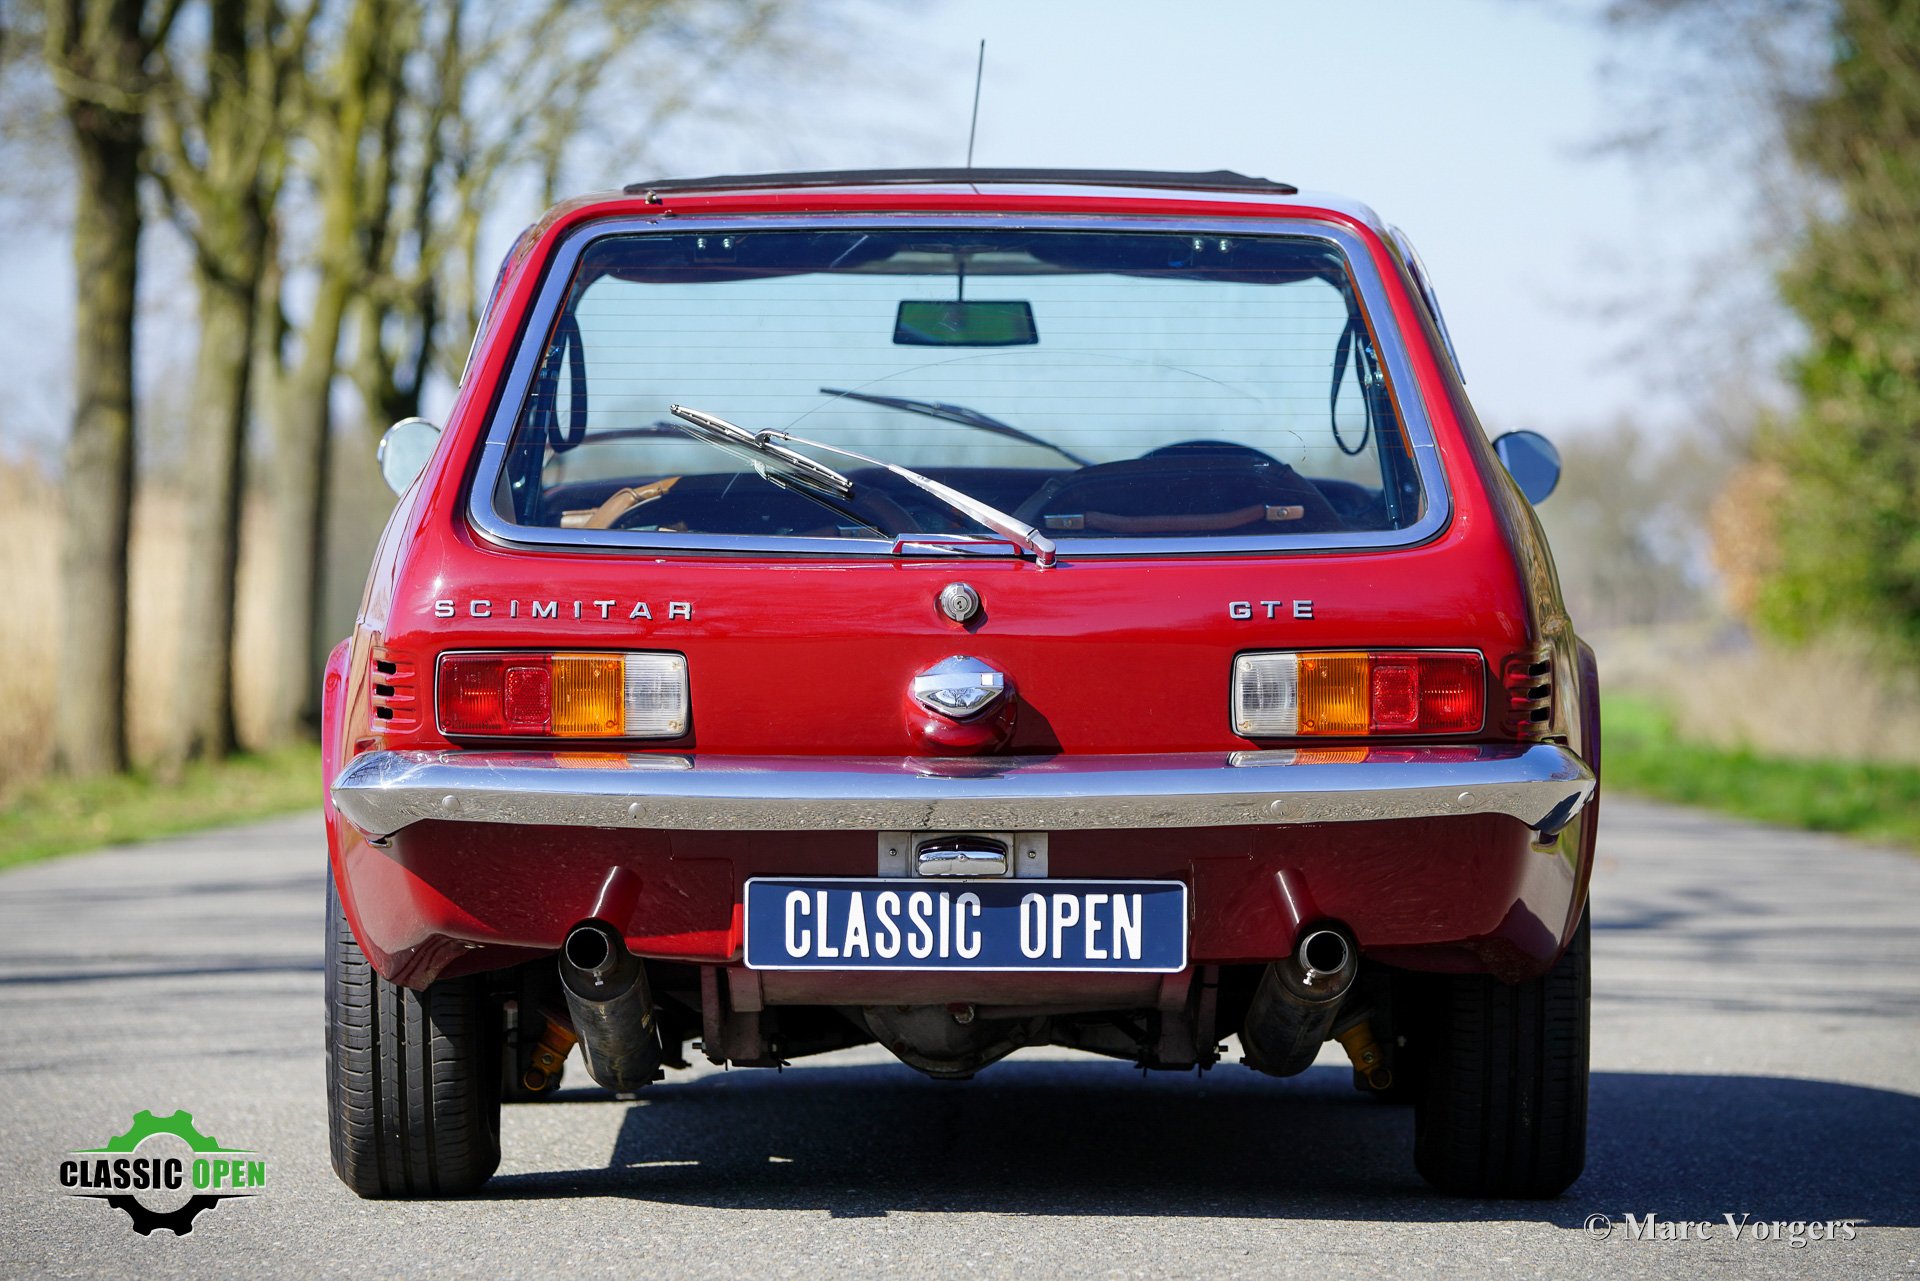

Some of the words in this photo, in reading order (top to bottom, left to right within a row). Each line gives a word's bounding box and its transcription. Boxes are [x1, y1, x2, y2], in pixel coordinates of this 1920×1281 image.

[434, 600, 692, 620] SCIMITAR
[1229, 600, 1314, 619] GTE
[785, 890, 982, 960] CLASSIC
[1020, 892, 1143, 960] OPEN
